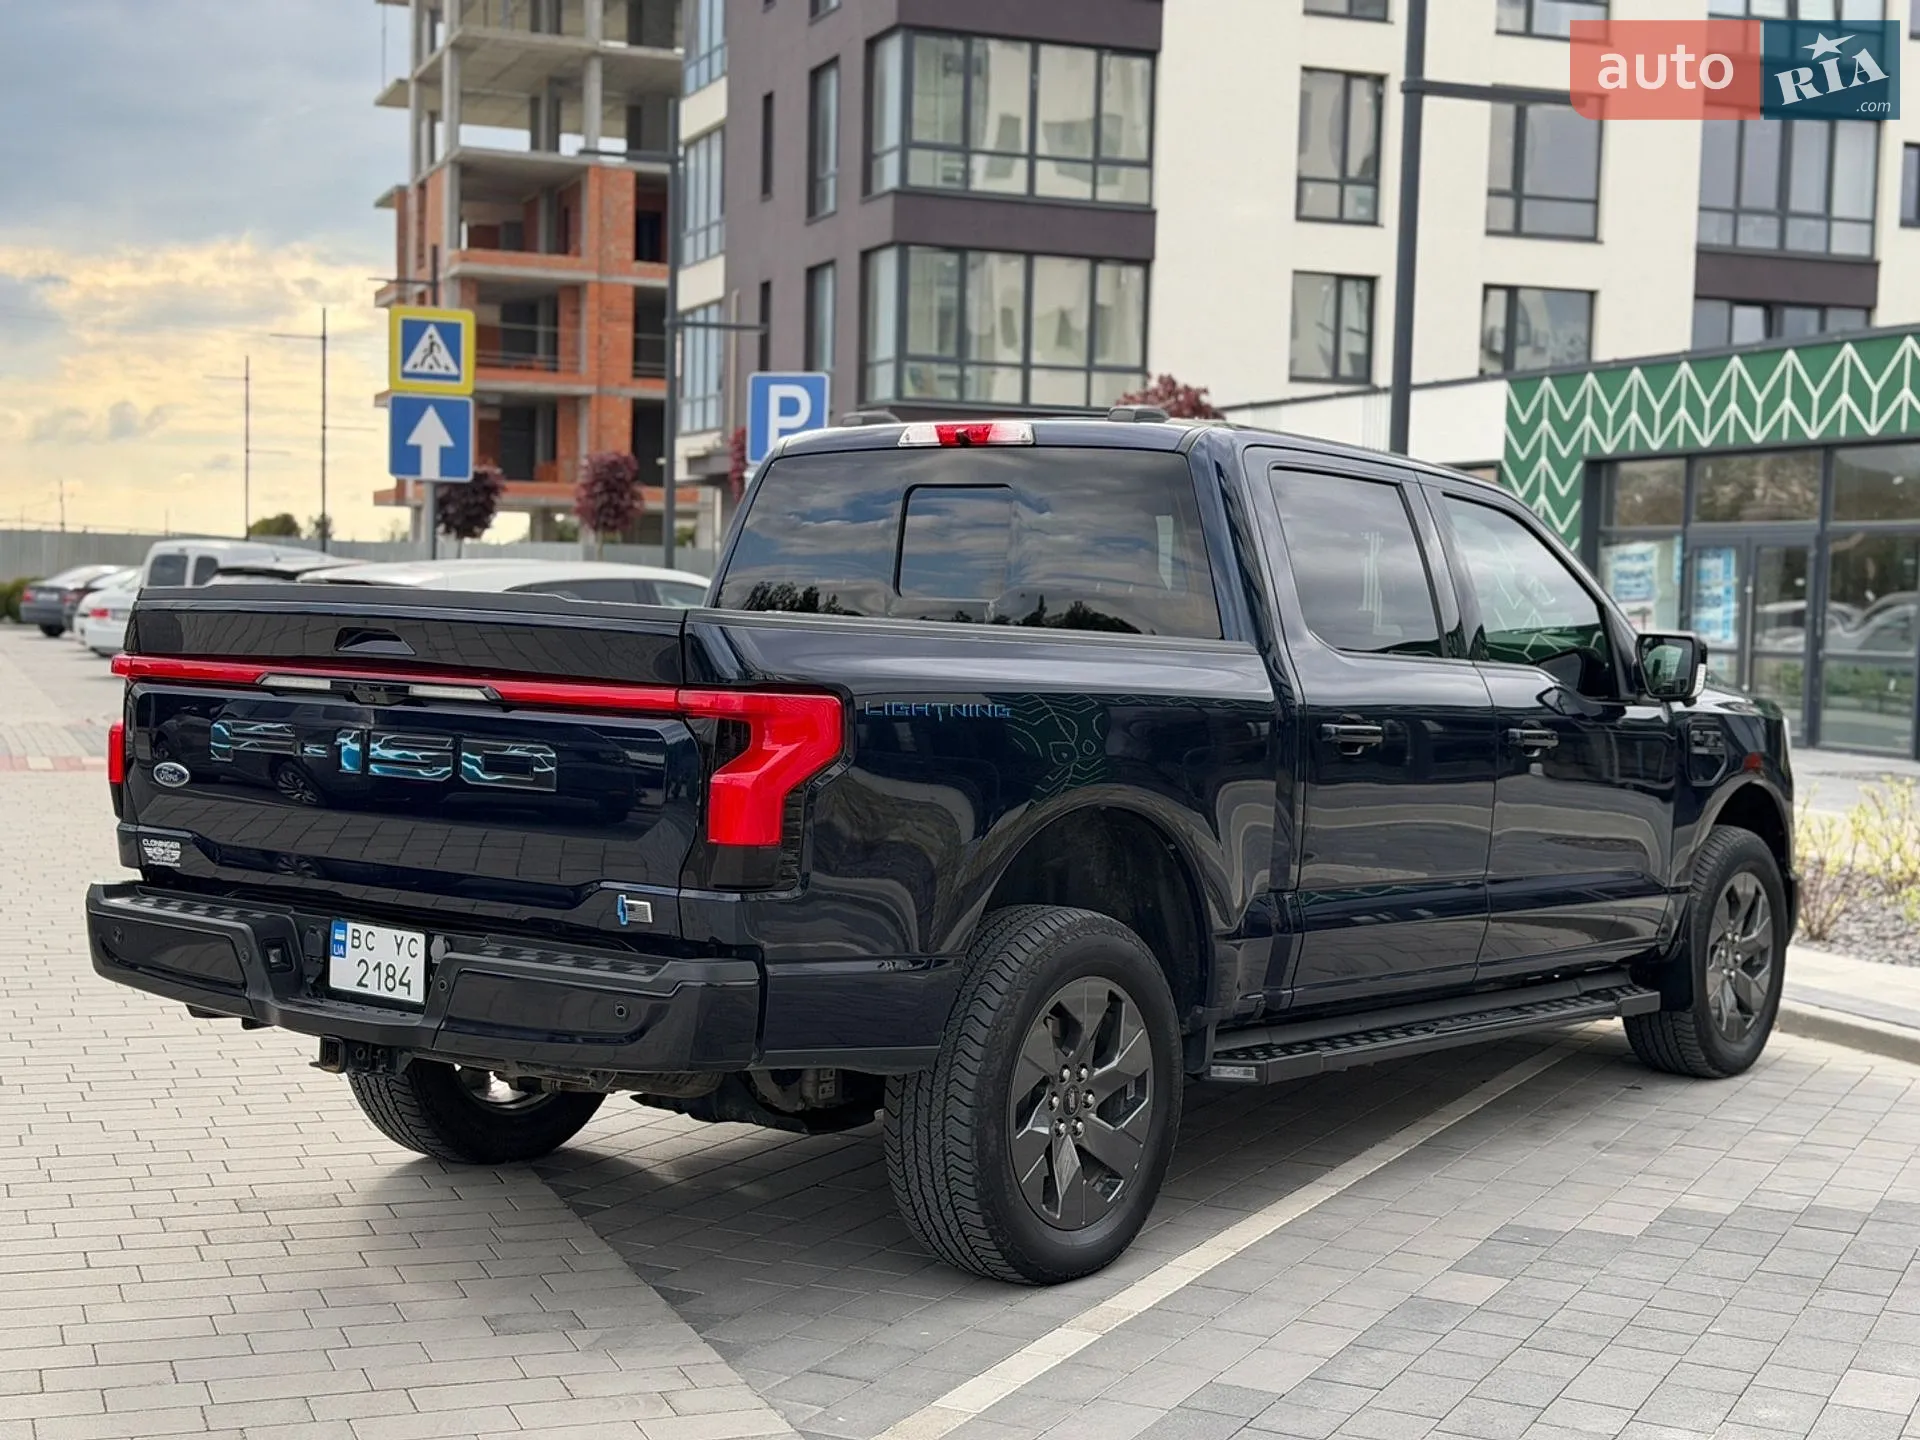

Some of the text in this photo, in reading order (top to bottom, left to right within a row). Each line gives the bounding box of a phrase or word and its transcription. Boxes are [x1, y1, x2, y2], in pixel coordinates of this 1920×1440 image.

[768, 384, 811, 450] P
[864, 700, 1012, 721] LIGHTNING
[209, 719, 557, 792] F-150
[333, 943, 344, 955] UA
[351, 928, 375, 951] BC
[356, 958, 411, 996] 2184
